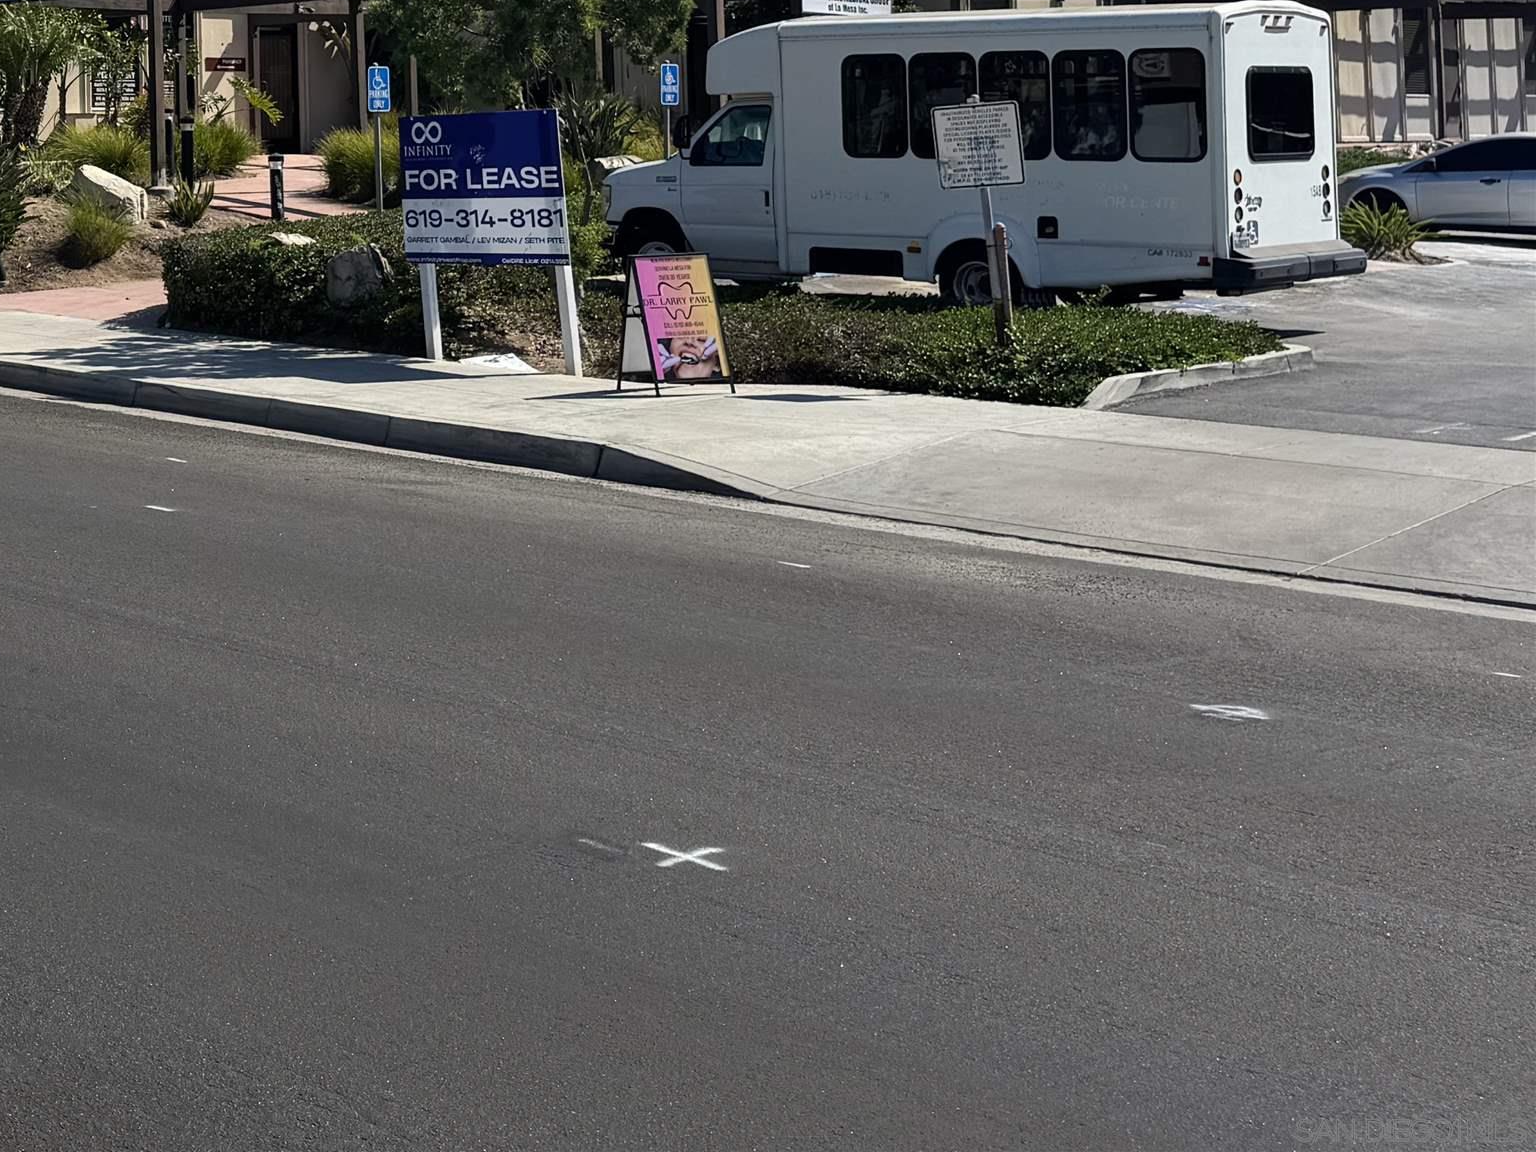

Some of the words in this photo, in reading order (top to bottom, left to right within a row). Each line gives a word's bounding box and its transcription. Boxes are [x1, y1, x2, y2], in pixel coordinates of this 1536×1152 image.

[404, 144, 452, 157] INFINITY
[405, 169, 458, 191] FOR
[466, 166, 560, 190] LEASE
[405, 209, 564, 228] 619-314-8181
[407, 236, 439, 244] GARRETT
[660, 297, 686, 305] LARRY
